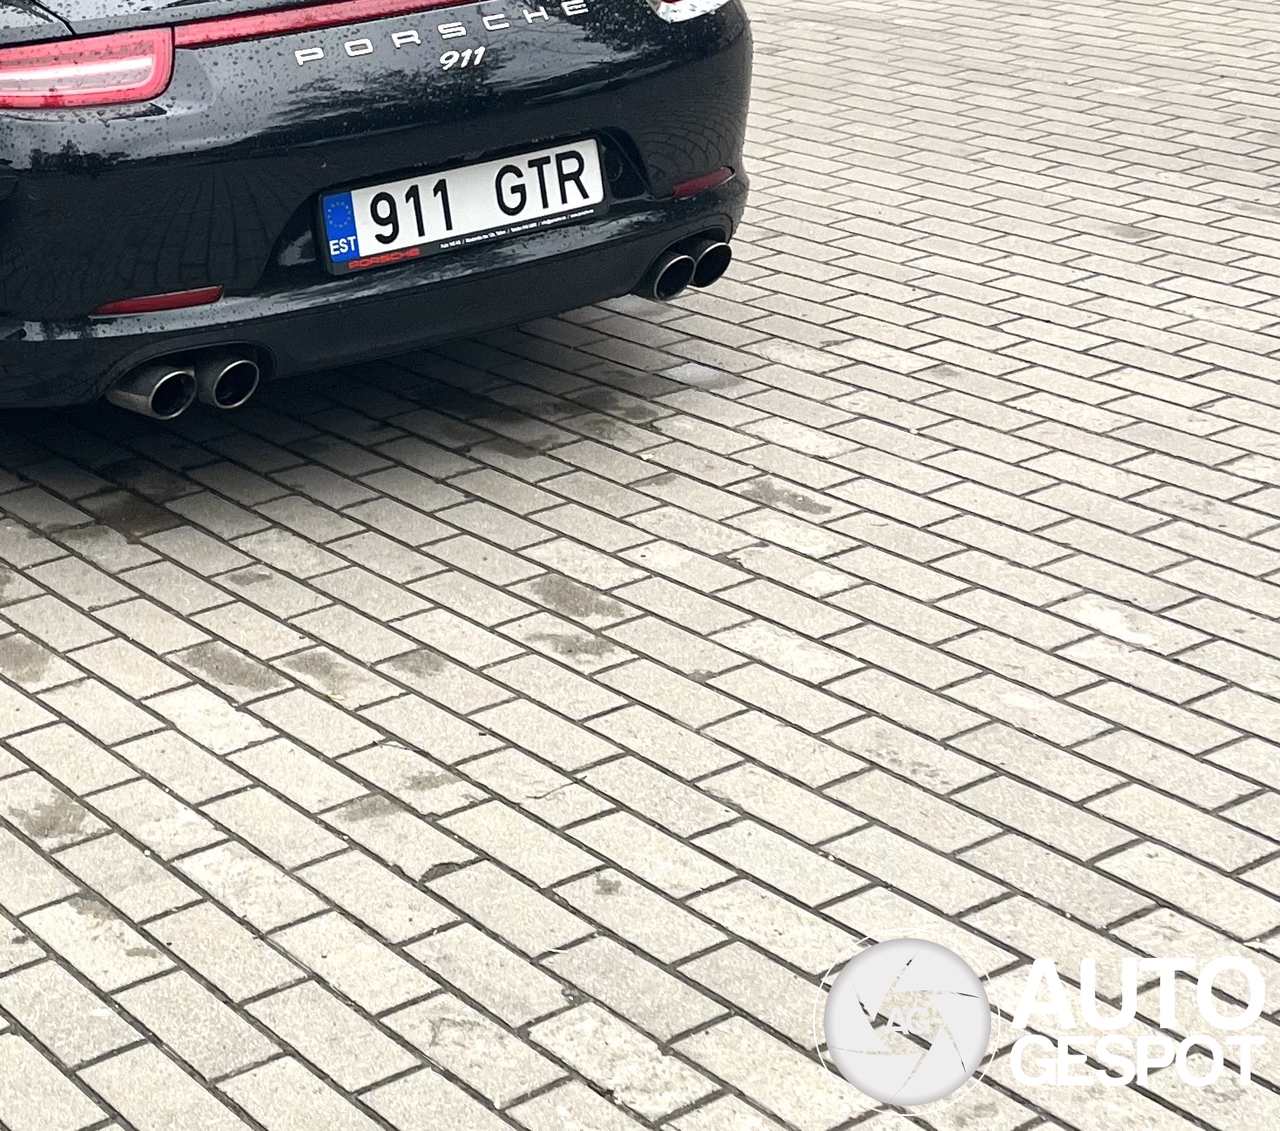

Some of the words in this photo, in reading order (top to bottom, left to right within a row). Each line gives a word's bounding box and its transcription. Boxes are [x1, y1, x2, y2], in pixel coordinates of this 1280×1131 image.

[439, 45, 486, 71] 911
[370, 178, 453, 245] 911
[495, 150, 590, 216] GTR
[329, 236, 357, 255] EST
[348, 248, 420, 270] PORSCHE
